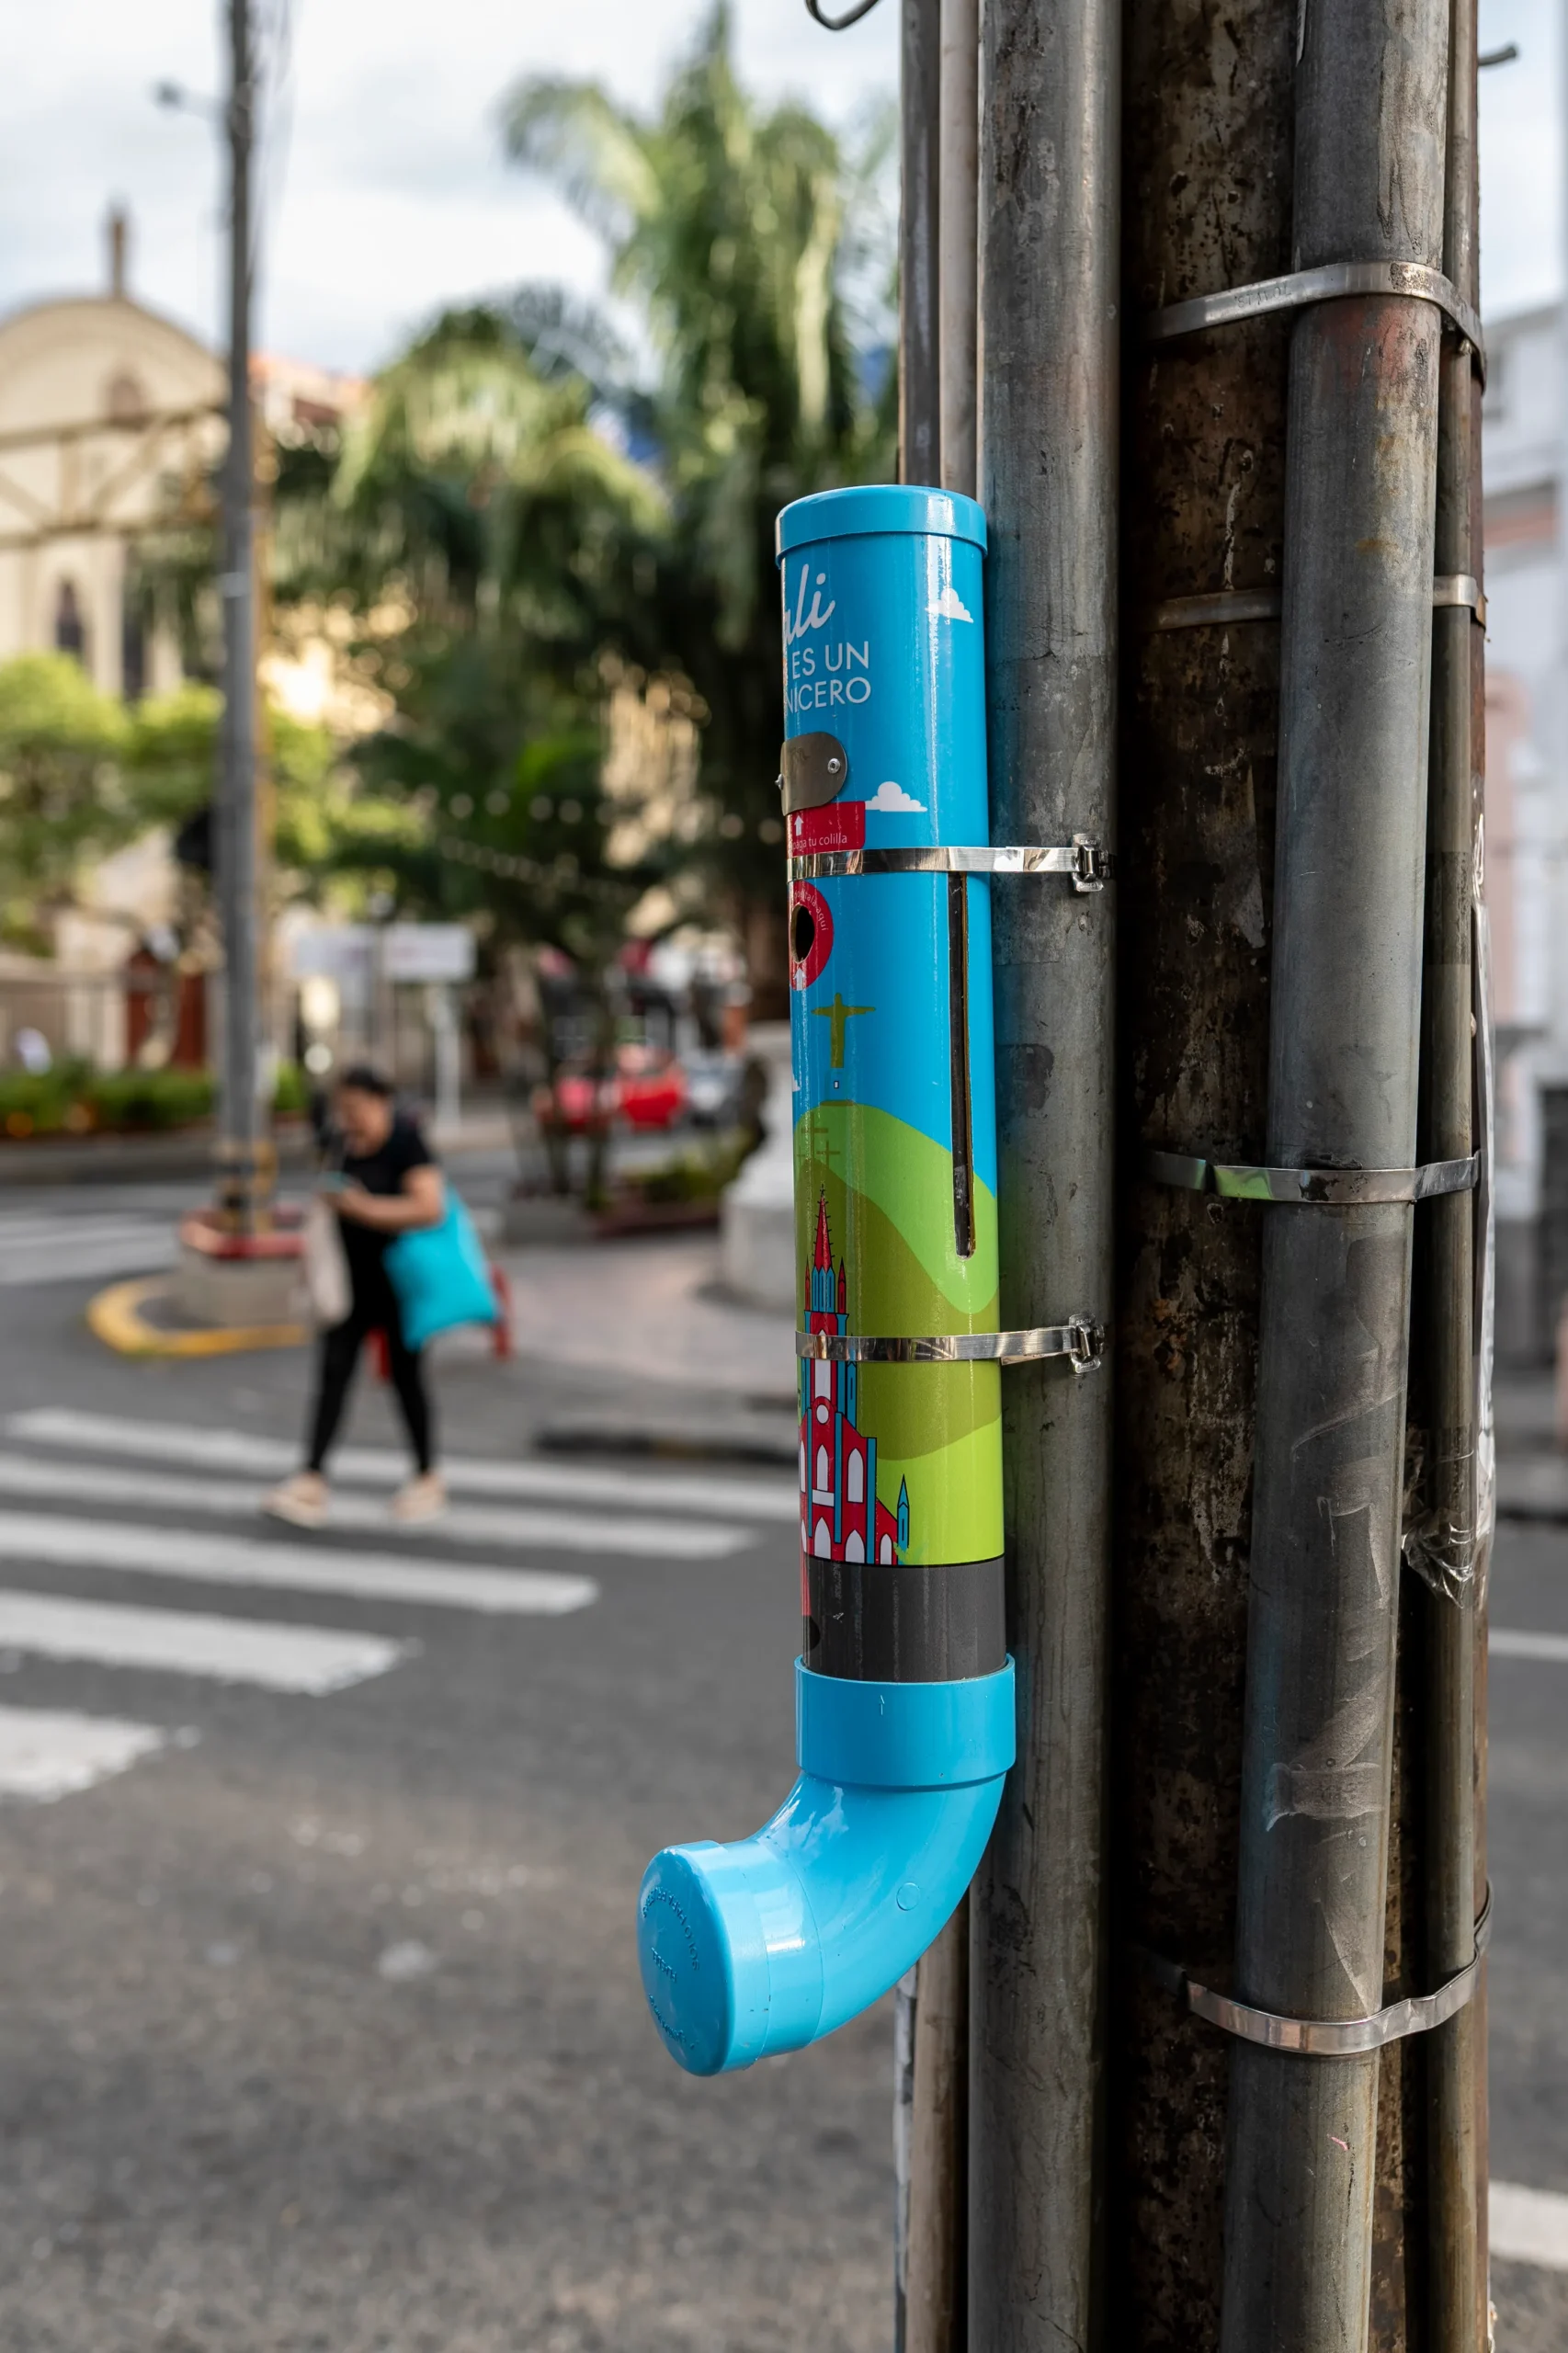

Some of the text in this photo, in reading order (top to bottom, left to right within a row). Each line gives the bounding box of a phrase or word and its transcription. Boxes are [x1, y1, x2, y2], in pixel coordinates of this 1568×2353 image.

[792, 641, 869, 680] ES UN
[808, 836, 817, 847] tu
[818, 832, 847, 846] colilla
